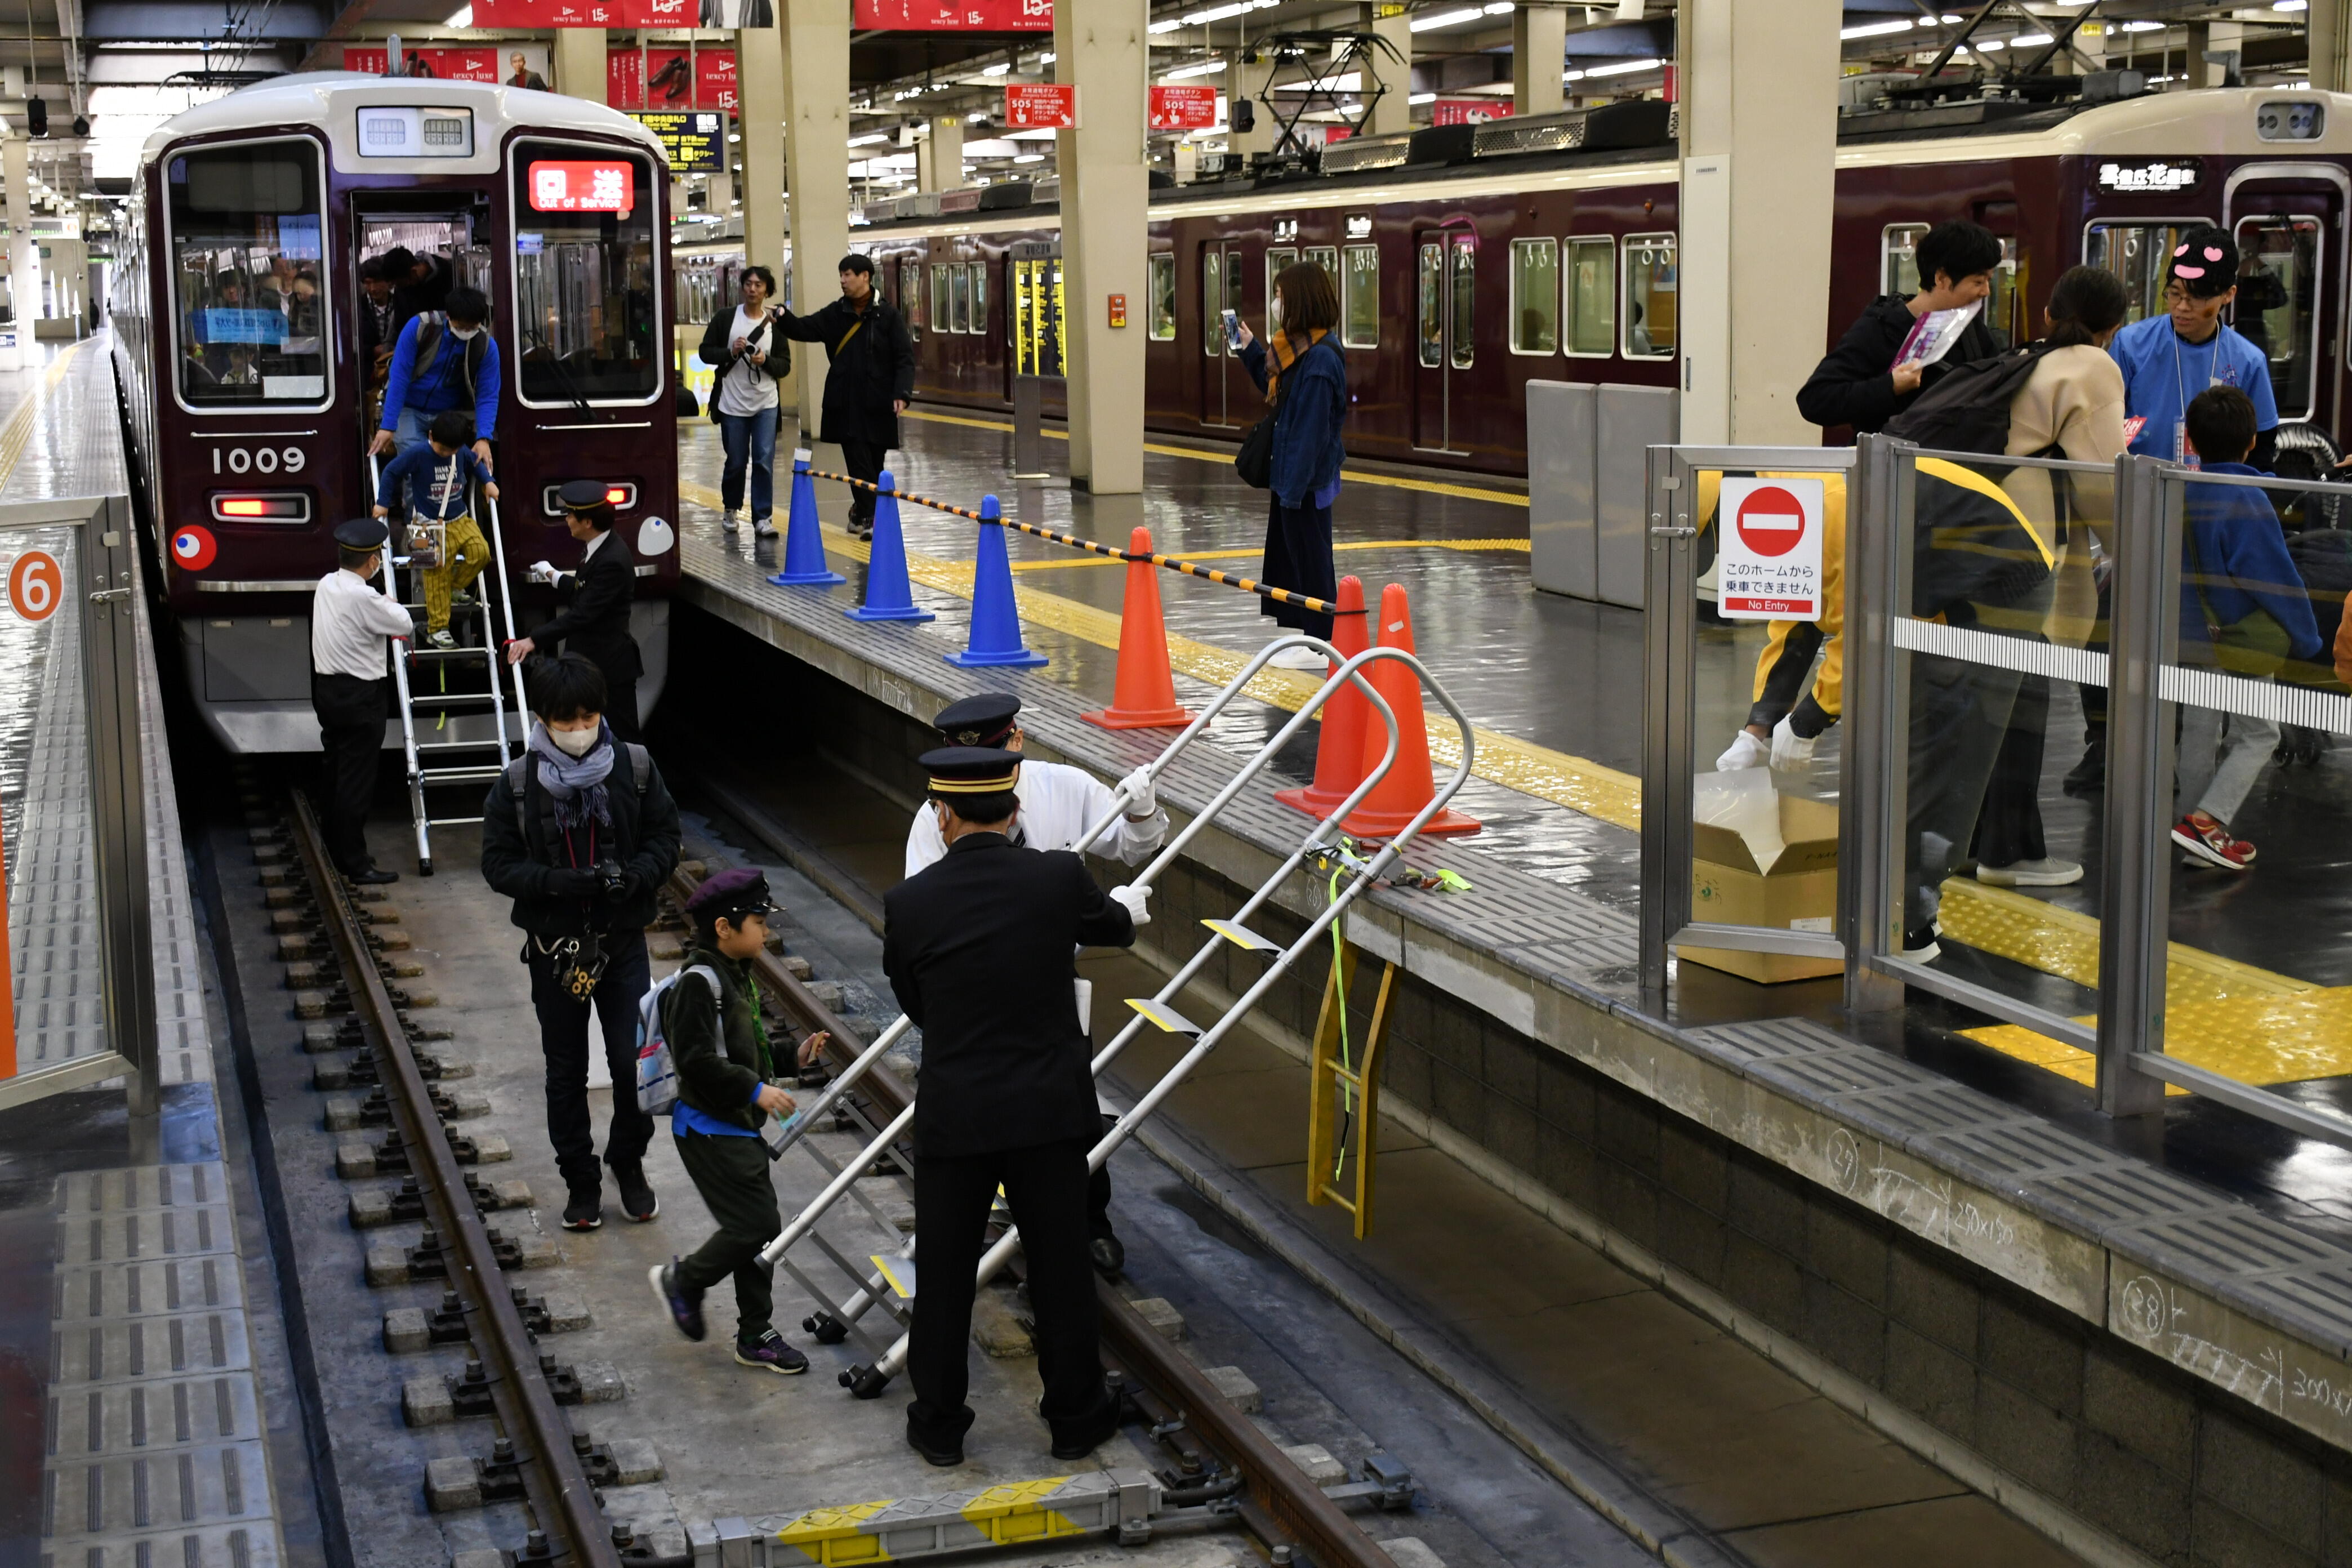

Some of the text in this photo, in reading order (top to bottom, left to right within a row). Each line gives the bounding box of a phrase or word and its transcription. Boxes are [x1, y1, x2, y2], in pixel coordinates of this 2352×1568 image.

[453, 70, 494, 80] texcy luxe
[706, 71, 736, 82] texcy lu
[1012, 99, 1031, 108] SOS
[1165, 101, 1184, 109] SOS
[537, 170, 623, 199] 回送
[538, 197, 621, 208] Out of Service
[212, 446, 305, 475] 1009
[1726, 563, 1814, 578] このホームから
[21, 561, 51, 612] 6
[1725, 580, 1814, 595] 乗車できません
[1748, 600, 1790, 612] No Entry
